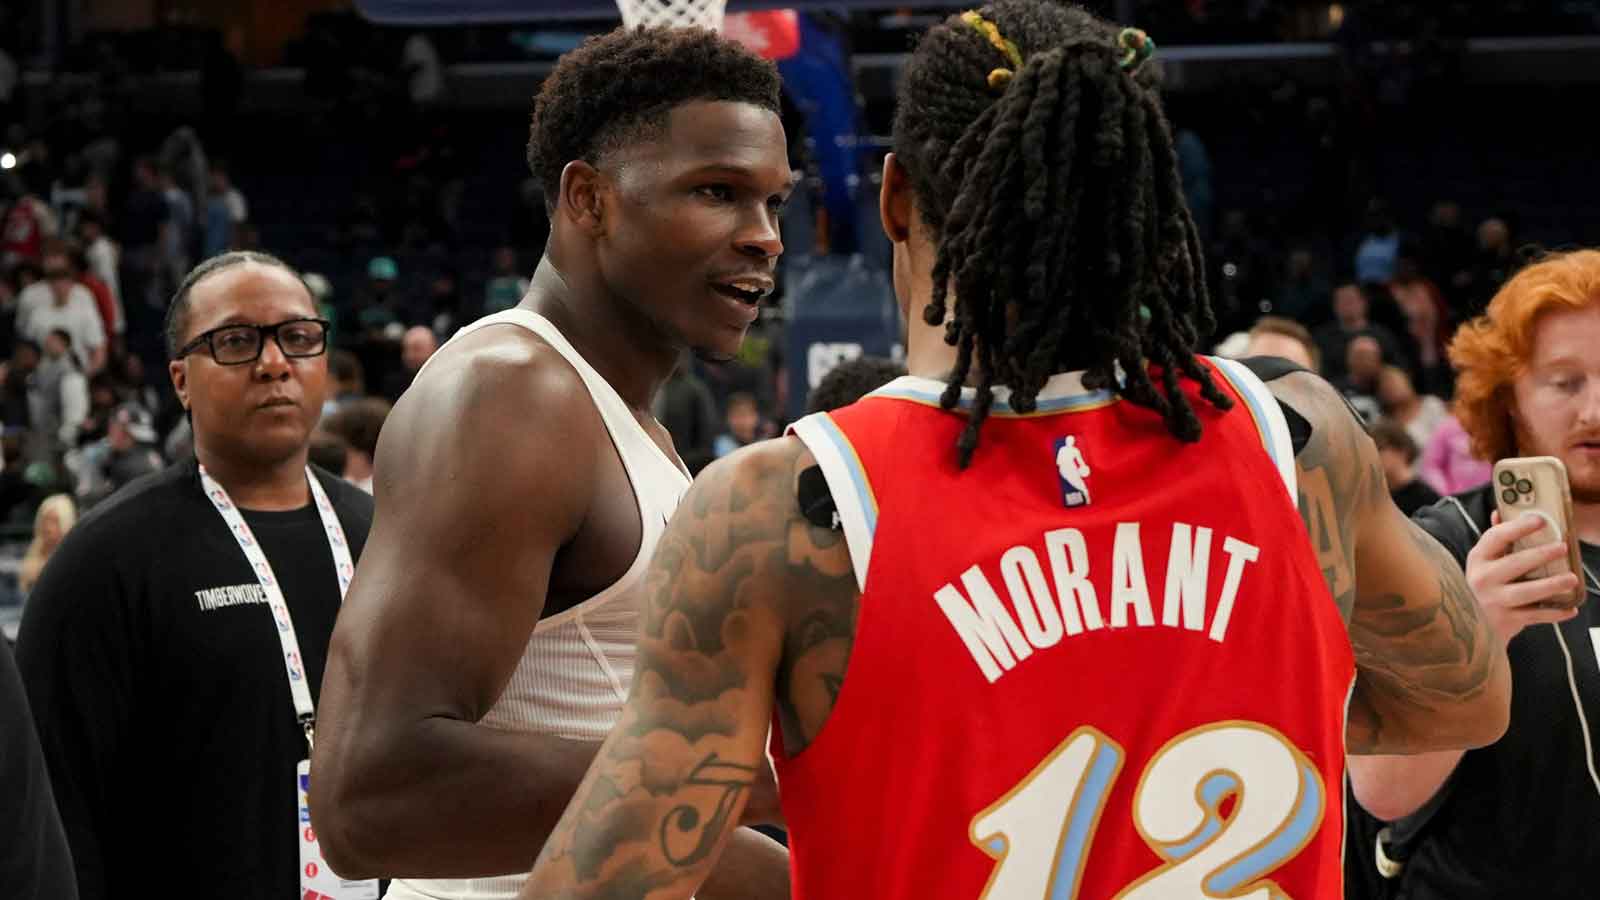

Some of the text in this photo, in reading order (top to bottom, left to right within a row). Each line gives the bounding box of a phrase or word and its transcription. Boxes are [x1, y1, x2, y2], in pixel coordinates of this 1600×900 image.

[194, 583, 269, 611] TIMBERWOLVE
[933, 521, 1260, 684] MORANT
[968, 719, 1326, 900] 12
